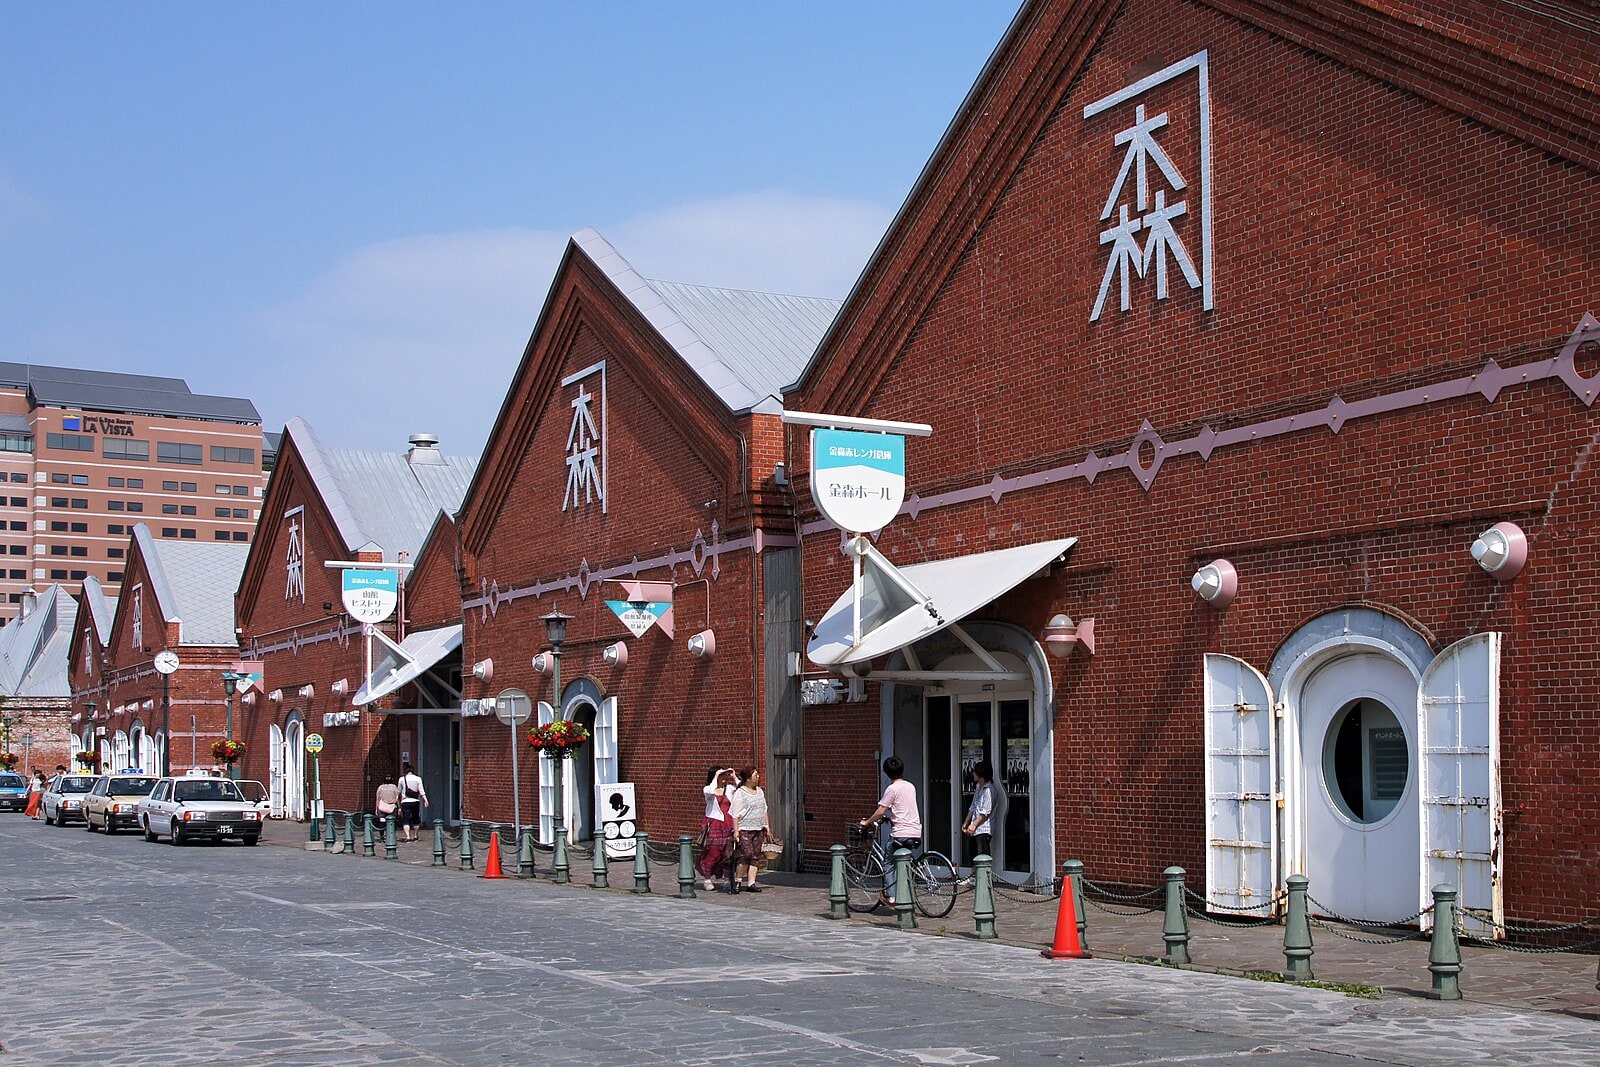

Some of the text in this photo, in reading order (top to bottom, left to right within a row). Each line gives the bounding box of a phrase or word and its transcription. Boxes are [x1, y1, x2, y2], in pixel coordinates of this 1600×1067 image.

[83, 421, 134, 436] LA VISTA
[829, 482, 893, 501] 金森ホール
[352, 599, 389, 608] ヒストリー
